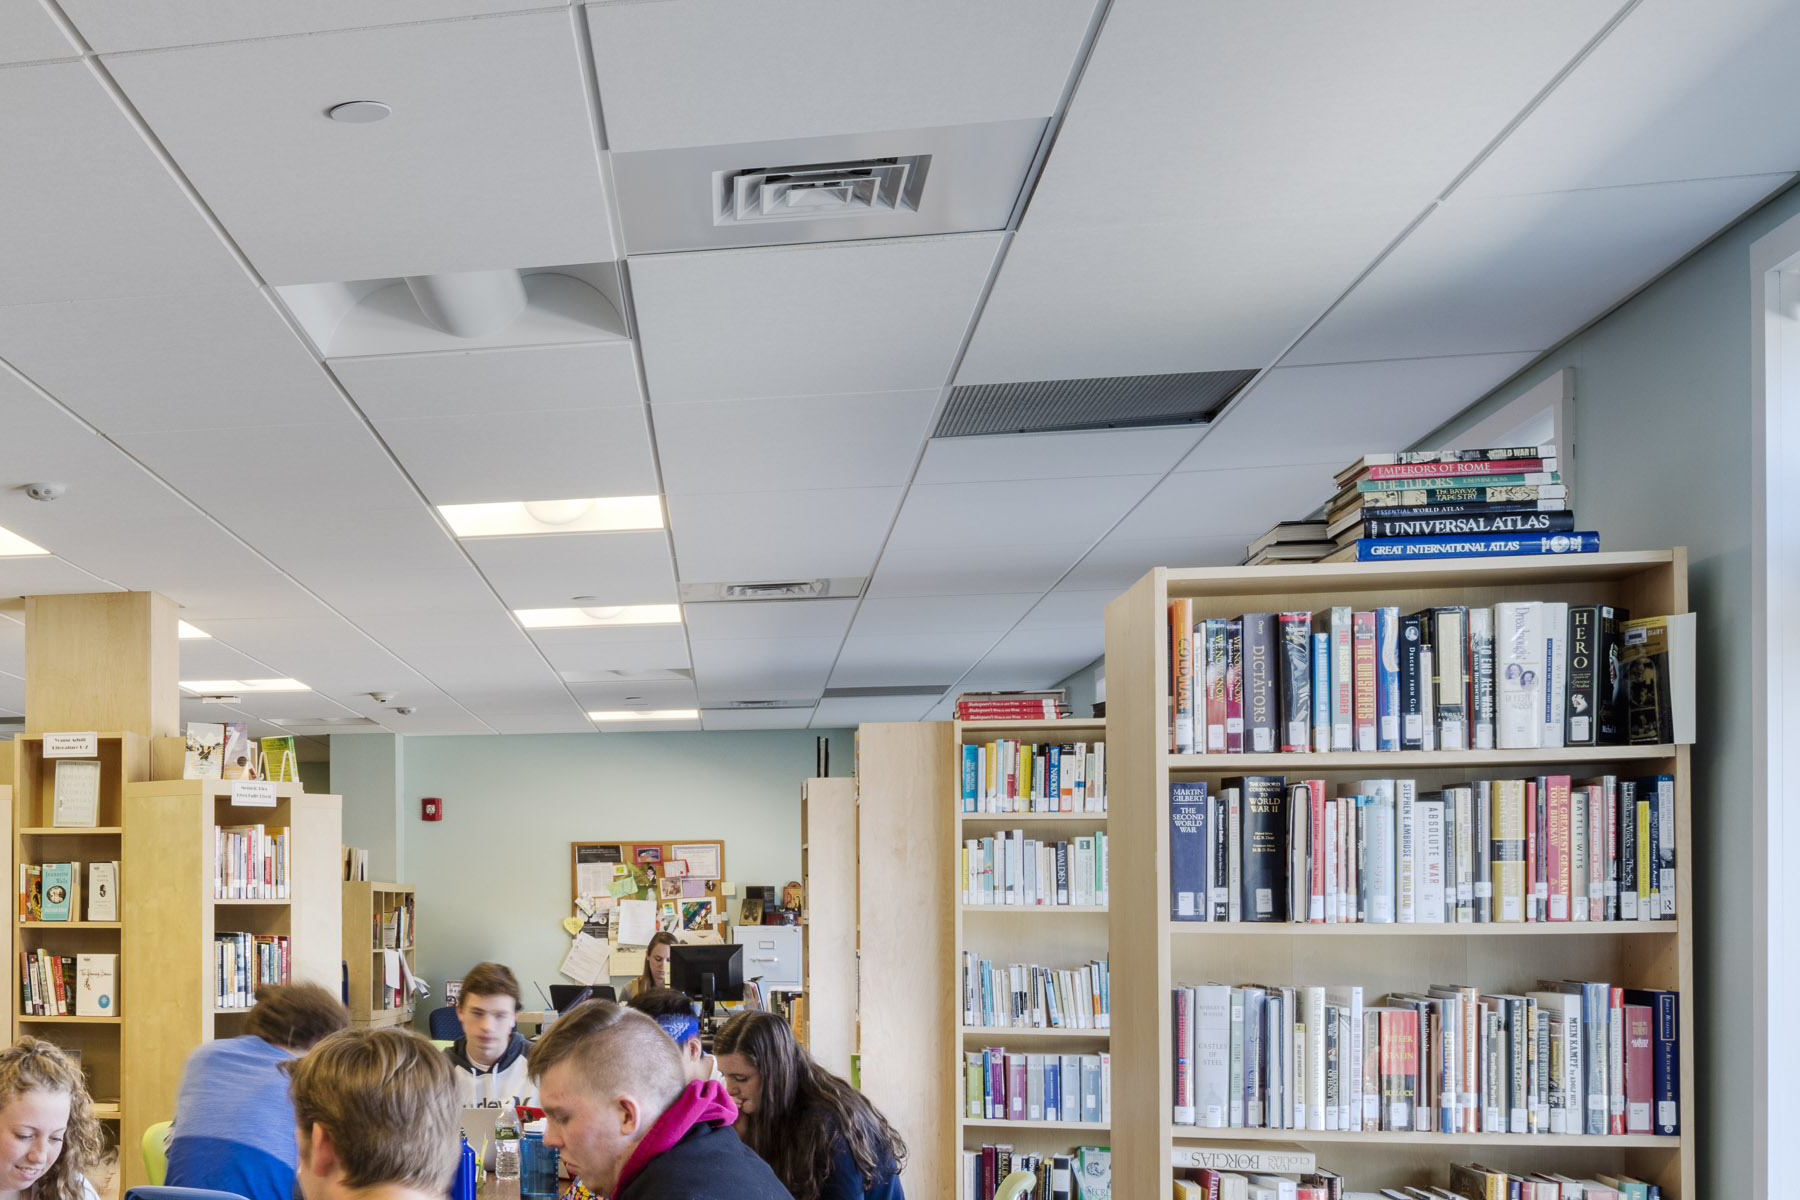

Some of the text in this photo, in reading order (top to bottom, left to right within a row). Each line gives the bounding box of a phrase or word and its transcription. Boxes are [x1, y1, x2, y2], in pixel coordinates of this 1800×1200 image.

[1374, 478, 1454, 490] THE TUDORS
[1378, 462, 1490, 476] EMPERORS OF ROME
[1376, 508, 1411, 516] ESSENTIAL
[1384, 514, 1550, 537] UNIVERSAL ATLAS
[1370, 540, 1520, 556] GREAT INTERNATIONAL ATLAS
[1340, 630, 1348, 645] THE
[1572, 612, 1589, 670] HERO
[1646, 628, 1664, 638] DIARY
[1216, 646, 1224, 704] NOW KNOW
[1233, 648, 1241, 705] NOW KNOW
[1252, 645, 1266, 723] DICTATORS
[1356, 644, 1374, 720] THE WHISPERERS
[1408, 646, 1416, 697] DESCENT FROM
[1480, 644, 1492, 718] TO END ALL WARS
[1340, 684, 1349, 714] READER
[1050, 768, 1058, 798] NABOKOV
[1374, 816, 1385, 860] LONDON
[1402, 784, 1412, 893] STEPHEN AMBROSE THE WILD
[1550, 786, 1558, 847] TOM BROKAW
[1560, 786, 1568, 852] THE GREATEST
[1057, 850, 1066, 874] WALDEN
[1428, 807, 1440, 884] ABSOLUTE WAR
[1444, 1031, 1455, 1068] BERLIN
[1538, 1030, 1547, 1088] HITLER HISTORY
[1569, 1017, 1578, 1092] MEIN KAMPF ADOLF
[1192, 1152, 1260, 1169] BORGIAS
[1210, 1176, 1220, 1200] ITALY
